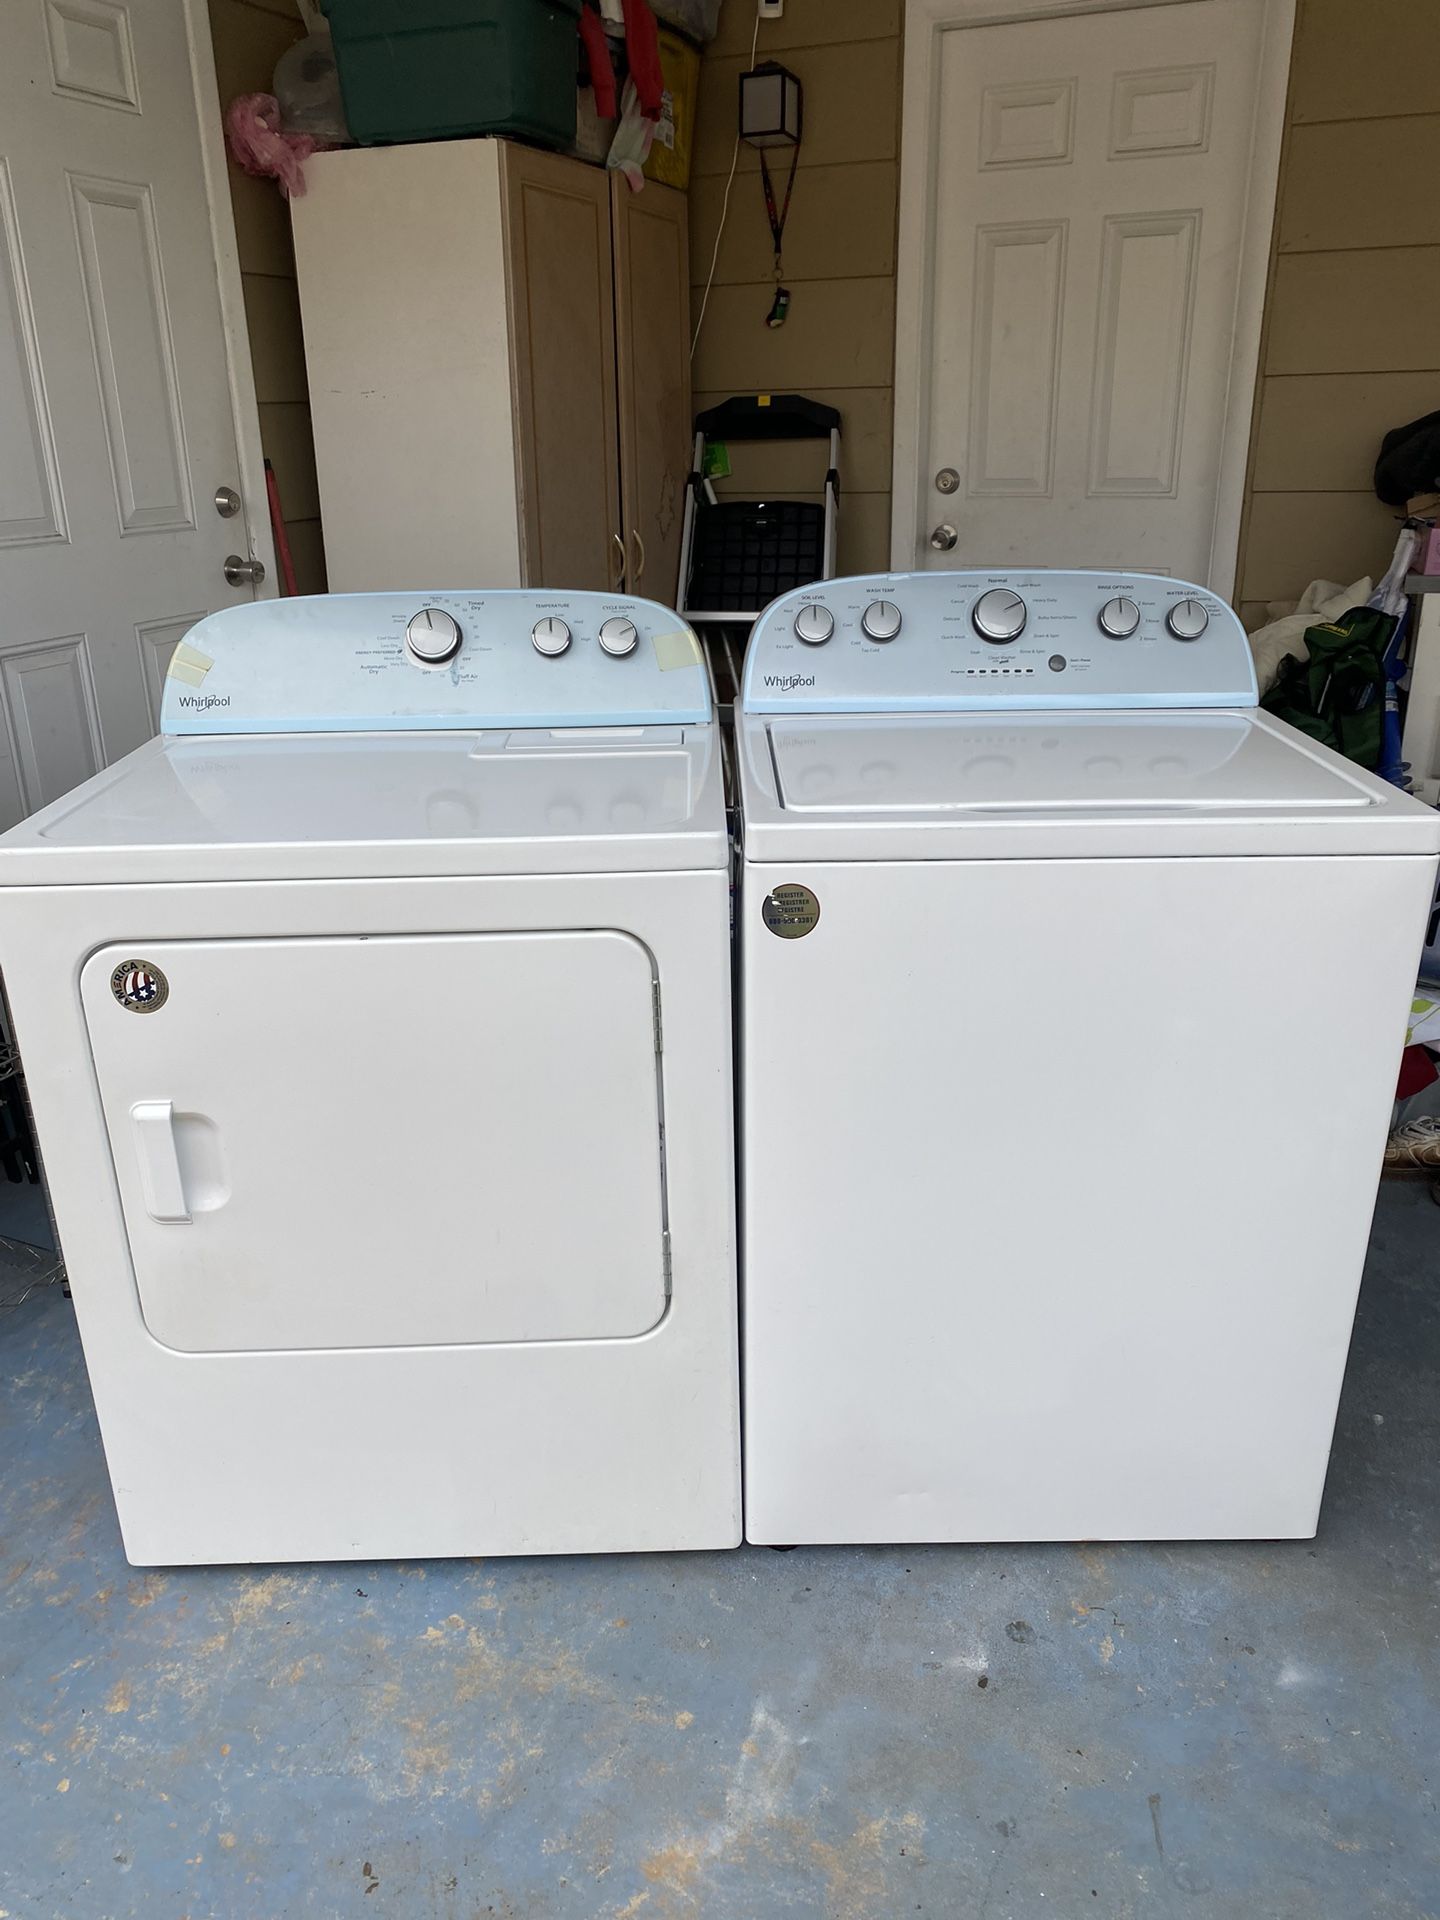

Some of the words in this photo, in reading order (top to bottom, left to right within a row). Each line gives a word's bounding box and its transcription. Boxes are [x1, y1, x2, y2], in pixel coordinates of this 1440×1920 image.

[763, 673, 815, 691] Whirlpool
[179, 694, 230, 712] Whirlpool
[113, 961, 138, 1006] AMERICA
